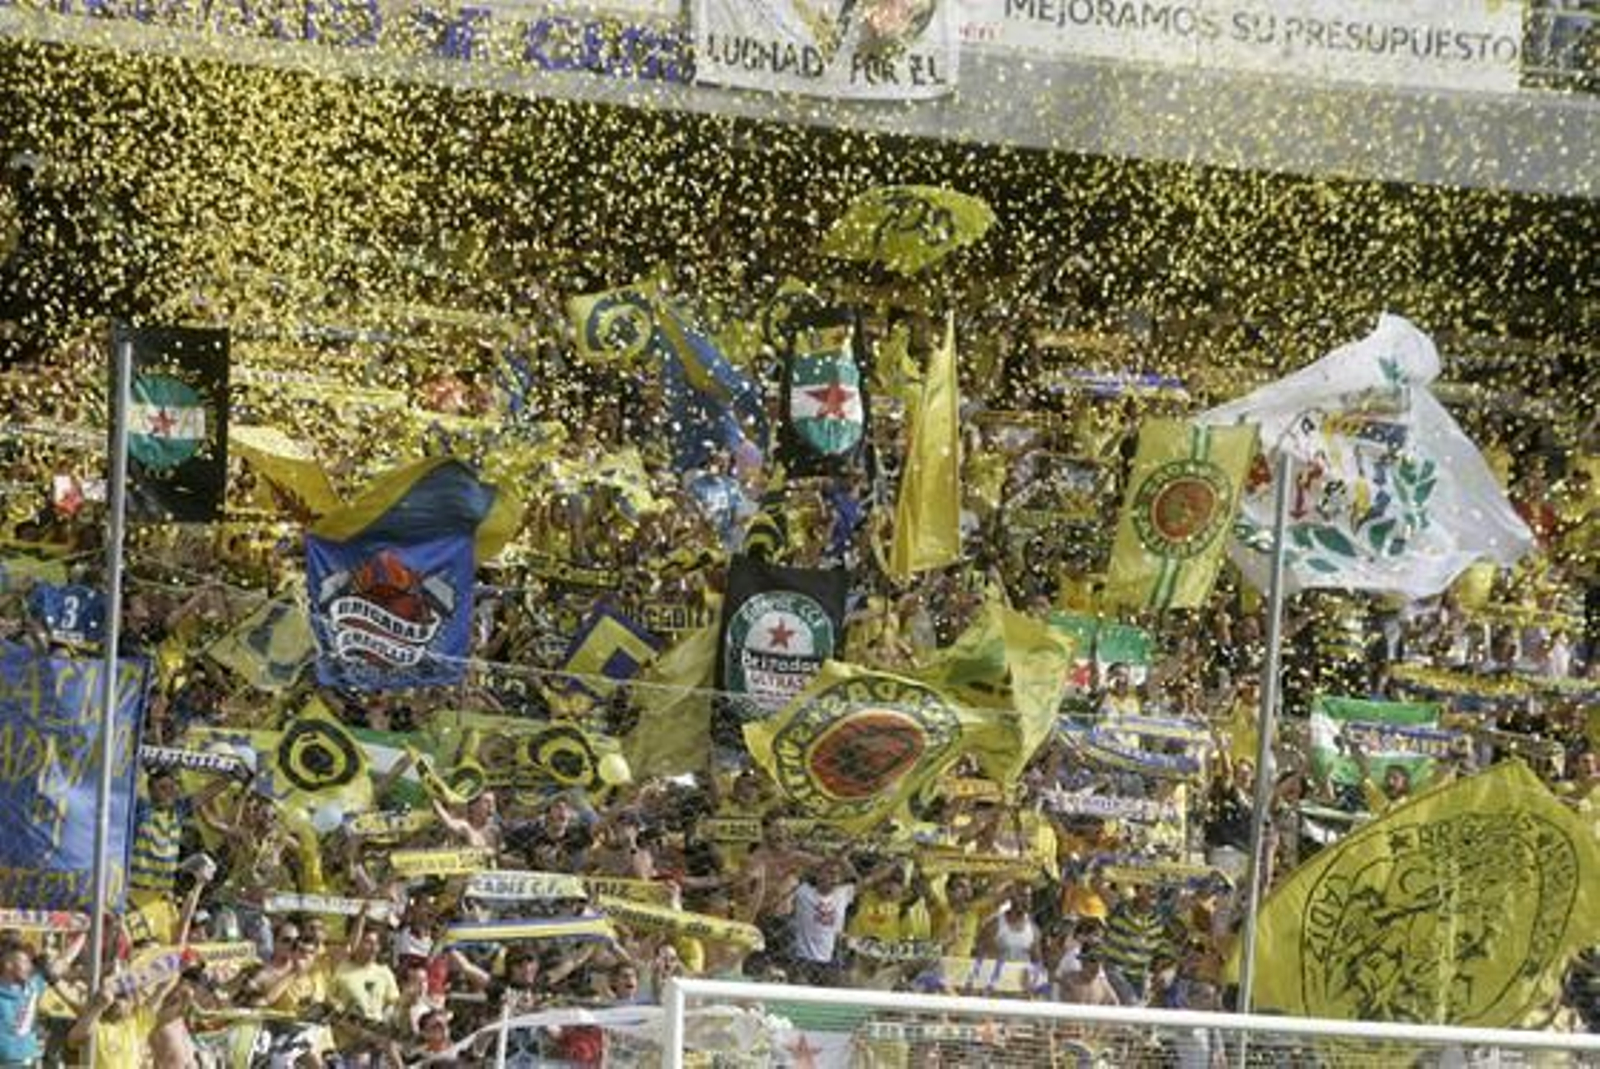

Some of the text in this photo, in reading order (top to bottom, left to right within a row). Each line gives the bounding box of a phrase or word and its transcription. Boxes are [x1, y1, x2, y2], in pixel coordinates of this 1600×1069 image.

[1004, 0, 1221, 39] MEJORAMOS
[1232, 12, 1275, 43] SU
[1285, 17, 1517, 62] PRESUPUESTO
[909, 53, 946, 85] EL
[61, 595, 79, 629] 3
